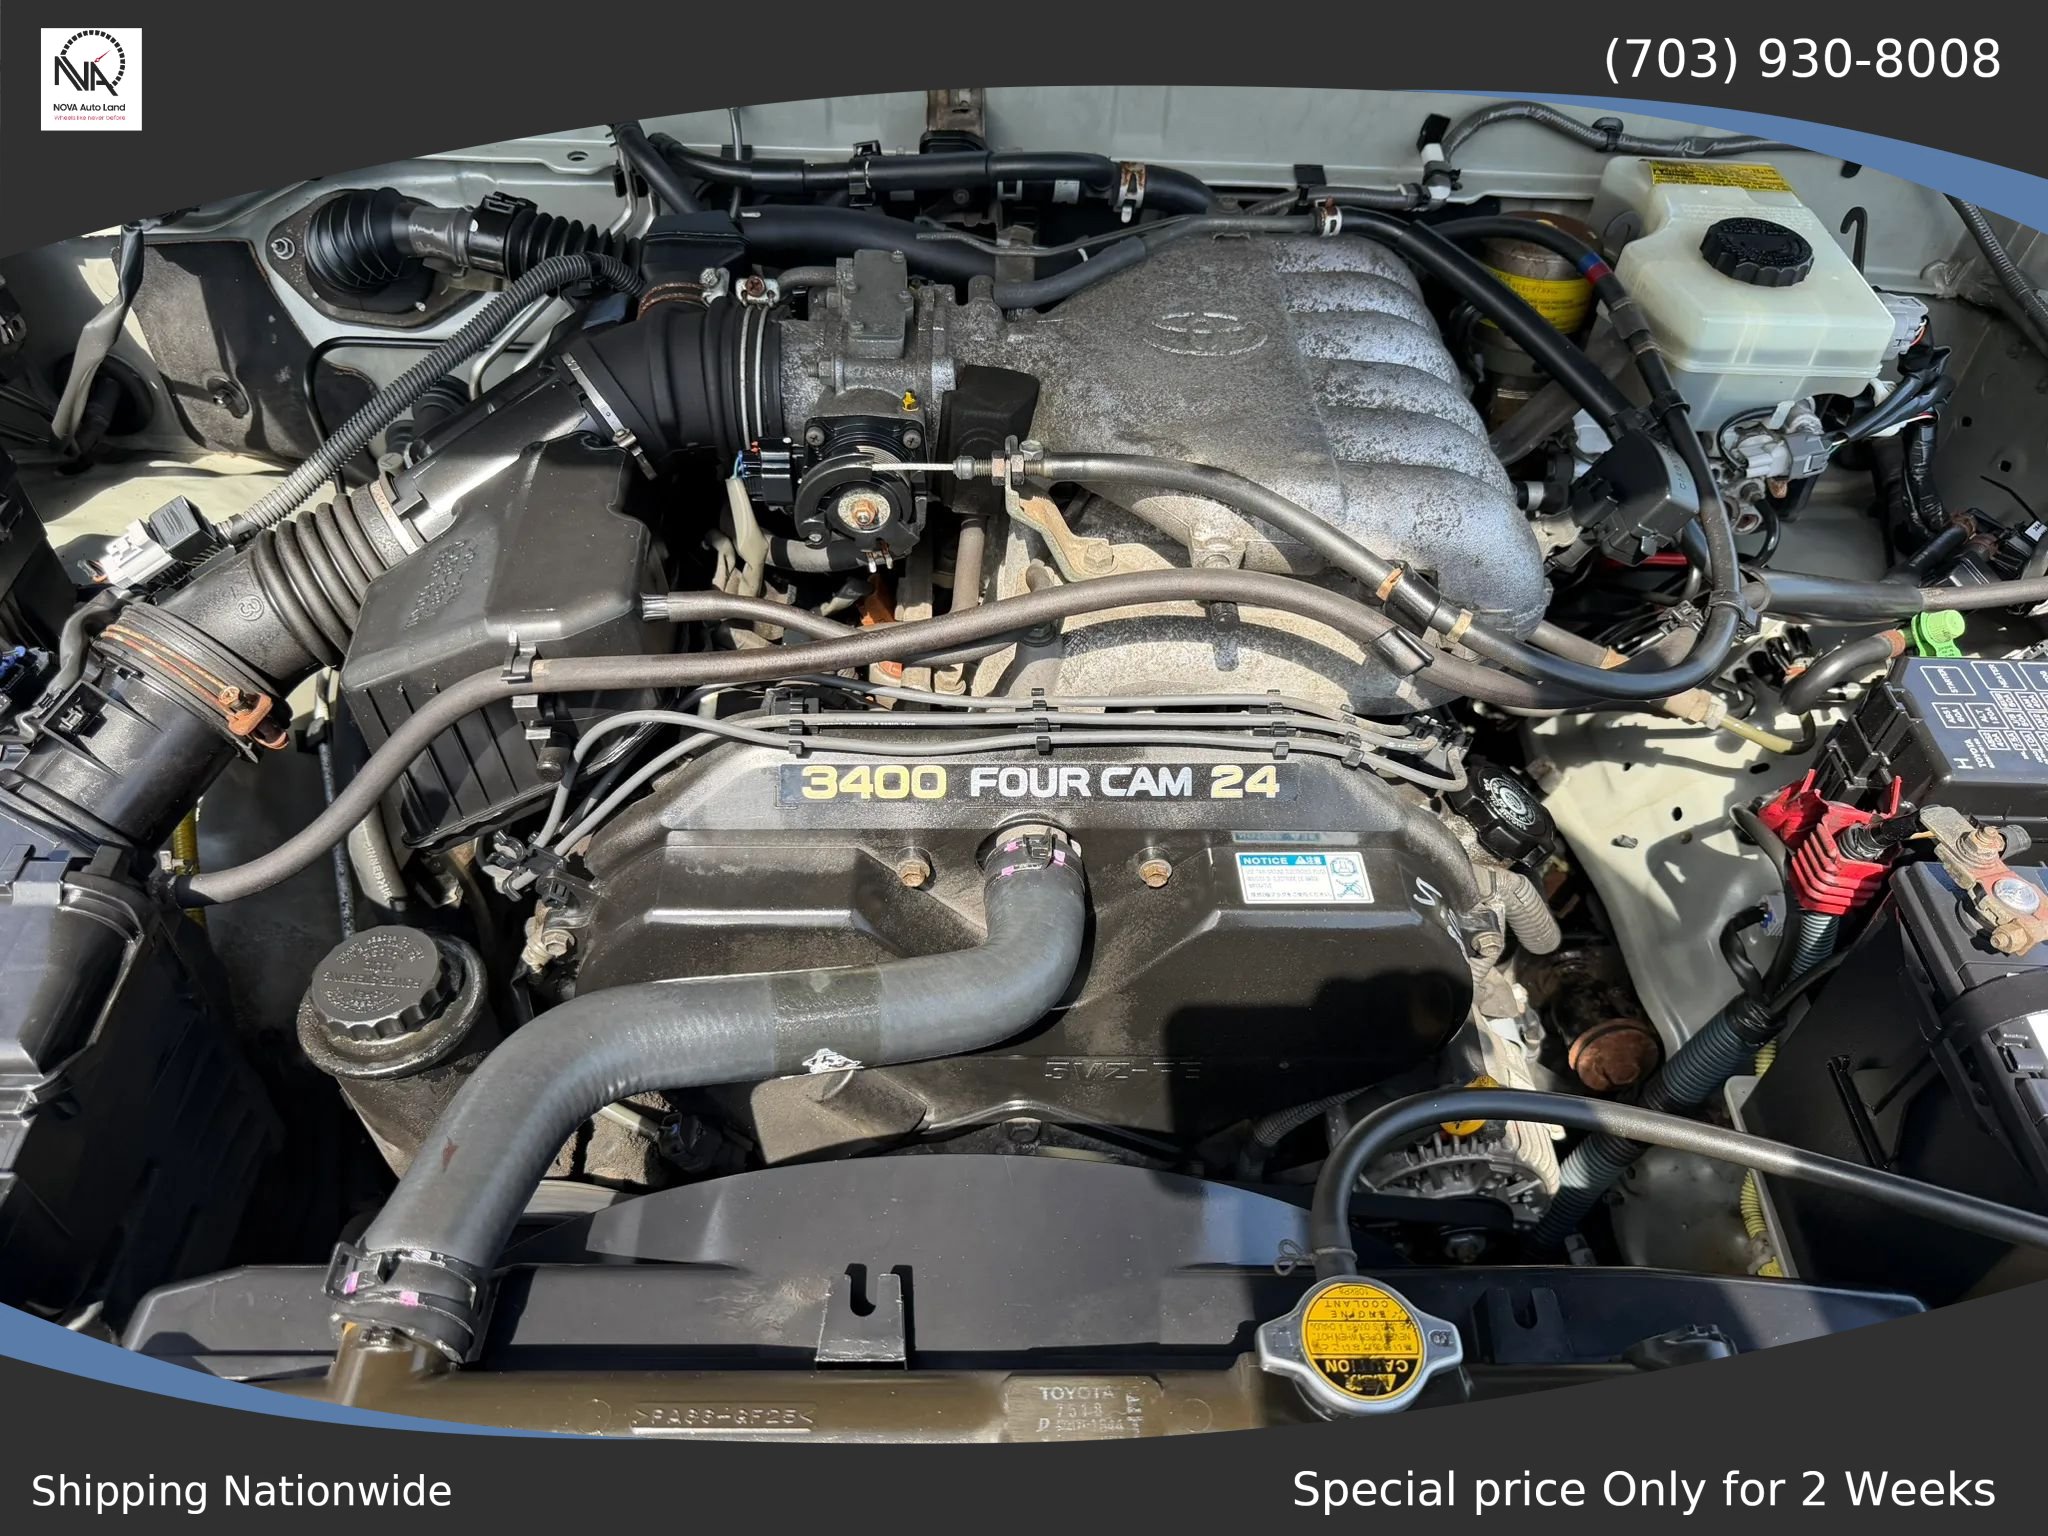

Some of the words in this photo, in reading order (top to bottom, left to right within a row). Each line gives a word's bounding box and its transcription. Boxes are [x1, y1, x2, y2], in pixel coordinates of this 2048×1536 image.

[1975, 708, 1990, 724] ALT
[1983, 706, 2001, 725] 120A
[1964, 738, 1987, 769] TOYOTA
[1953, 757, 1975, 770] H
[801, 764, 947, 800] 3400
[970, 766, 1092, 798] FOUR
[1101, 766, 1193, 798] CAM
[1210, 764, 1281, 799] 24
[1242, 856, 1289, 866] NOTICE
[1323, 1300, 1388, 1309] COOLANT
[1038, 1385, 1115, 1401] TOYOTA
